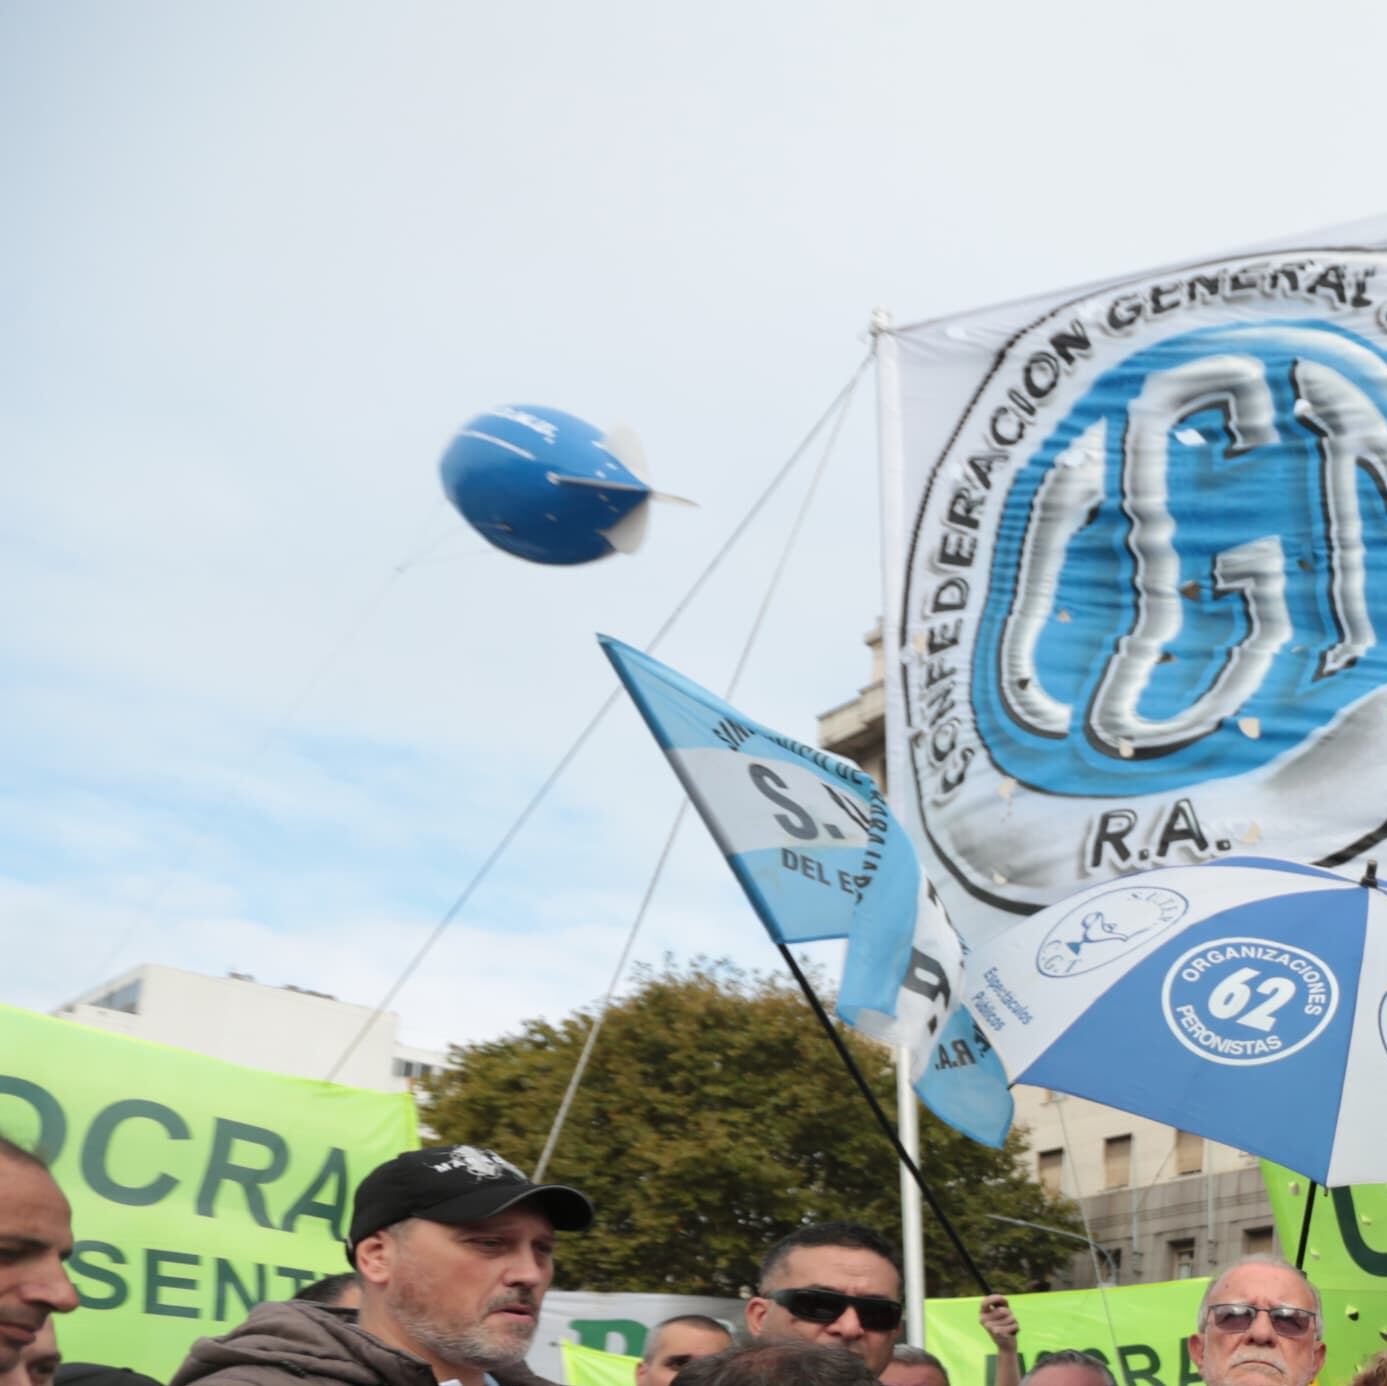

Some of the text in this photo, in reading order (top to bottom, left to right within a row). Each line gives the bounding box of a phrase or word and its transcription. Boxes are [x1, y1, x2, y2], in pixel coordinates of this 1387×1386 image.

[781, 848, 831, 886] DEL
[1090, 799, 1231, 869] R.A.
[1181, 945, 1326, 1016] ORGANIZACIONES
[1208, 967, 1297, 1033] 62
[1176, 1004, 1283, 1056] PERONISTAS
